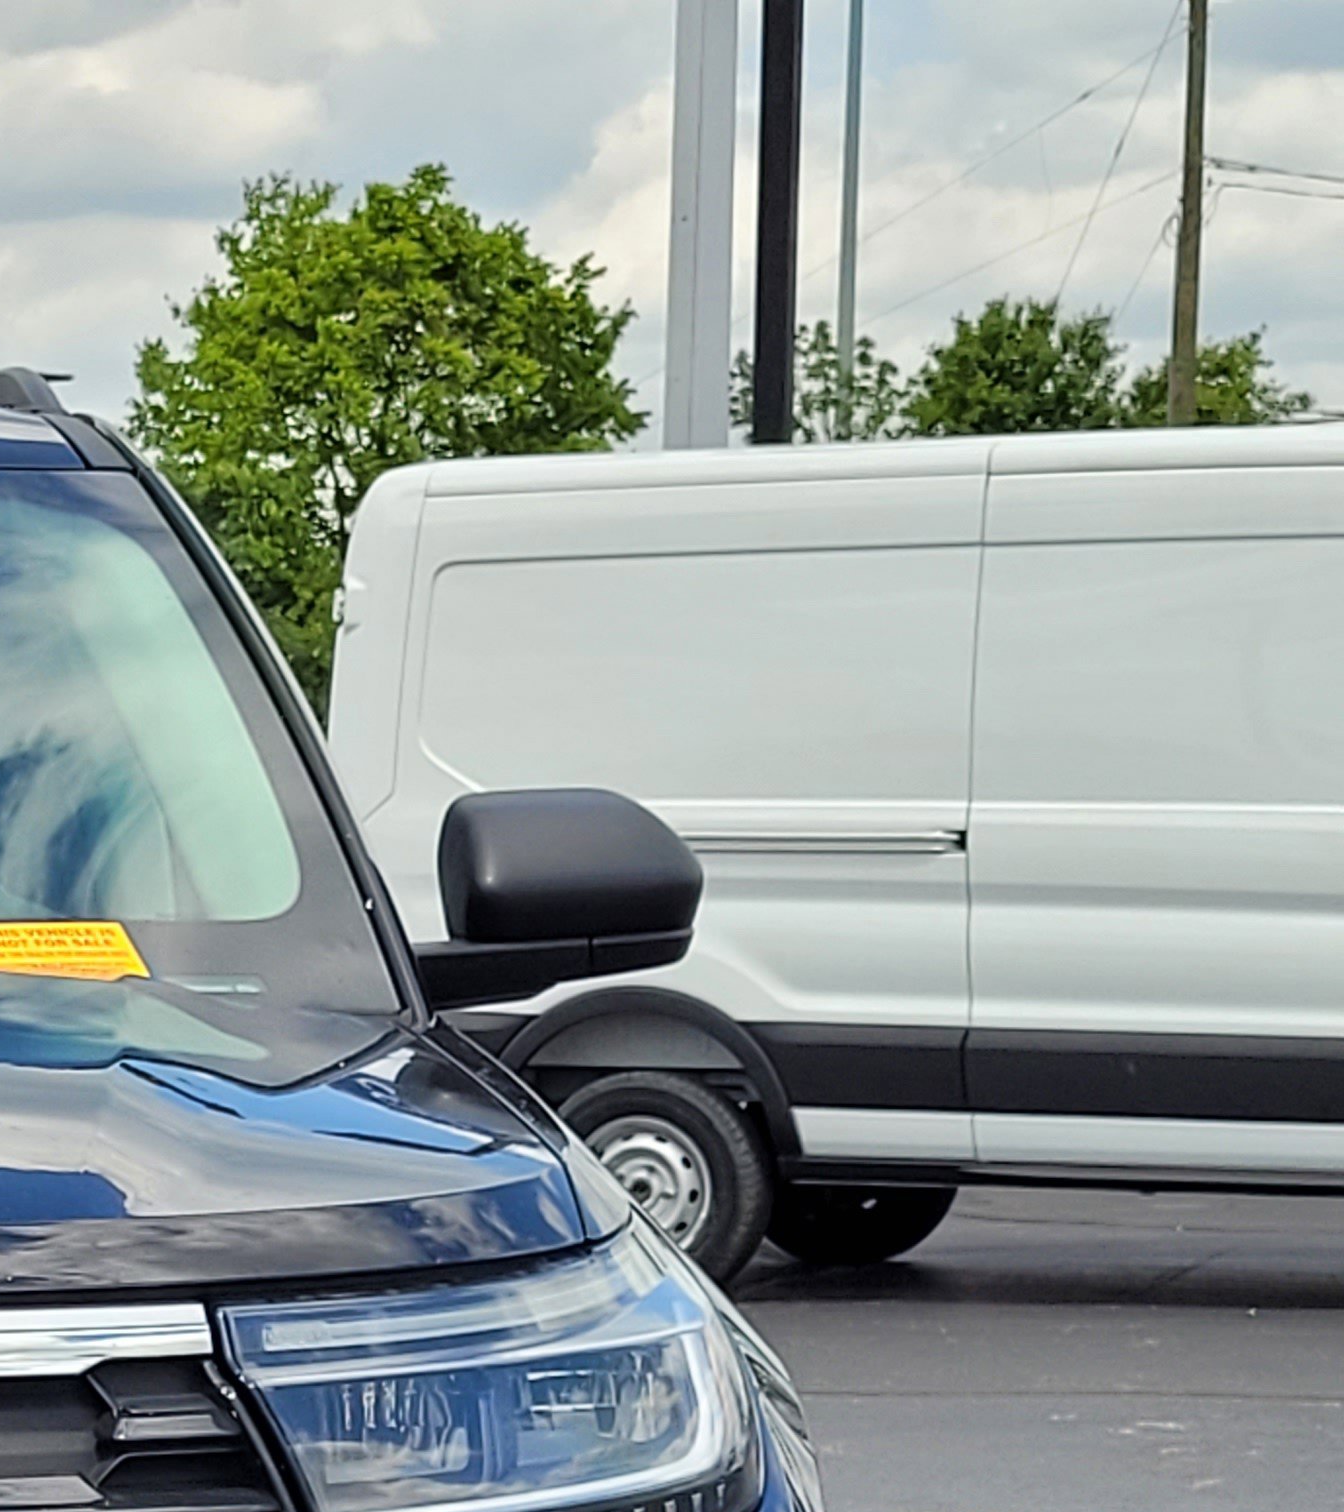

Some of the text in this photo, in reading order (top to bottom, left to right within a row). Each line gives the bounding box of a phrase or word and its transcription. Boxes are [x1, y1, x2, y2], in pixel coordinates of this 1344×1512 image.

[23, 928, 93, 937] VEHICLE
[99, 928, 116, 937] IS
[33, 938, 68, 947] FOR
[72, 938, 113, 947] SALE
